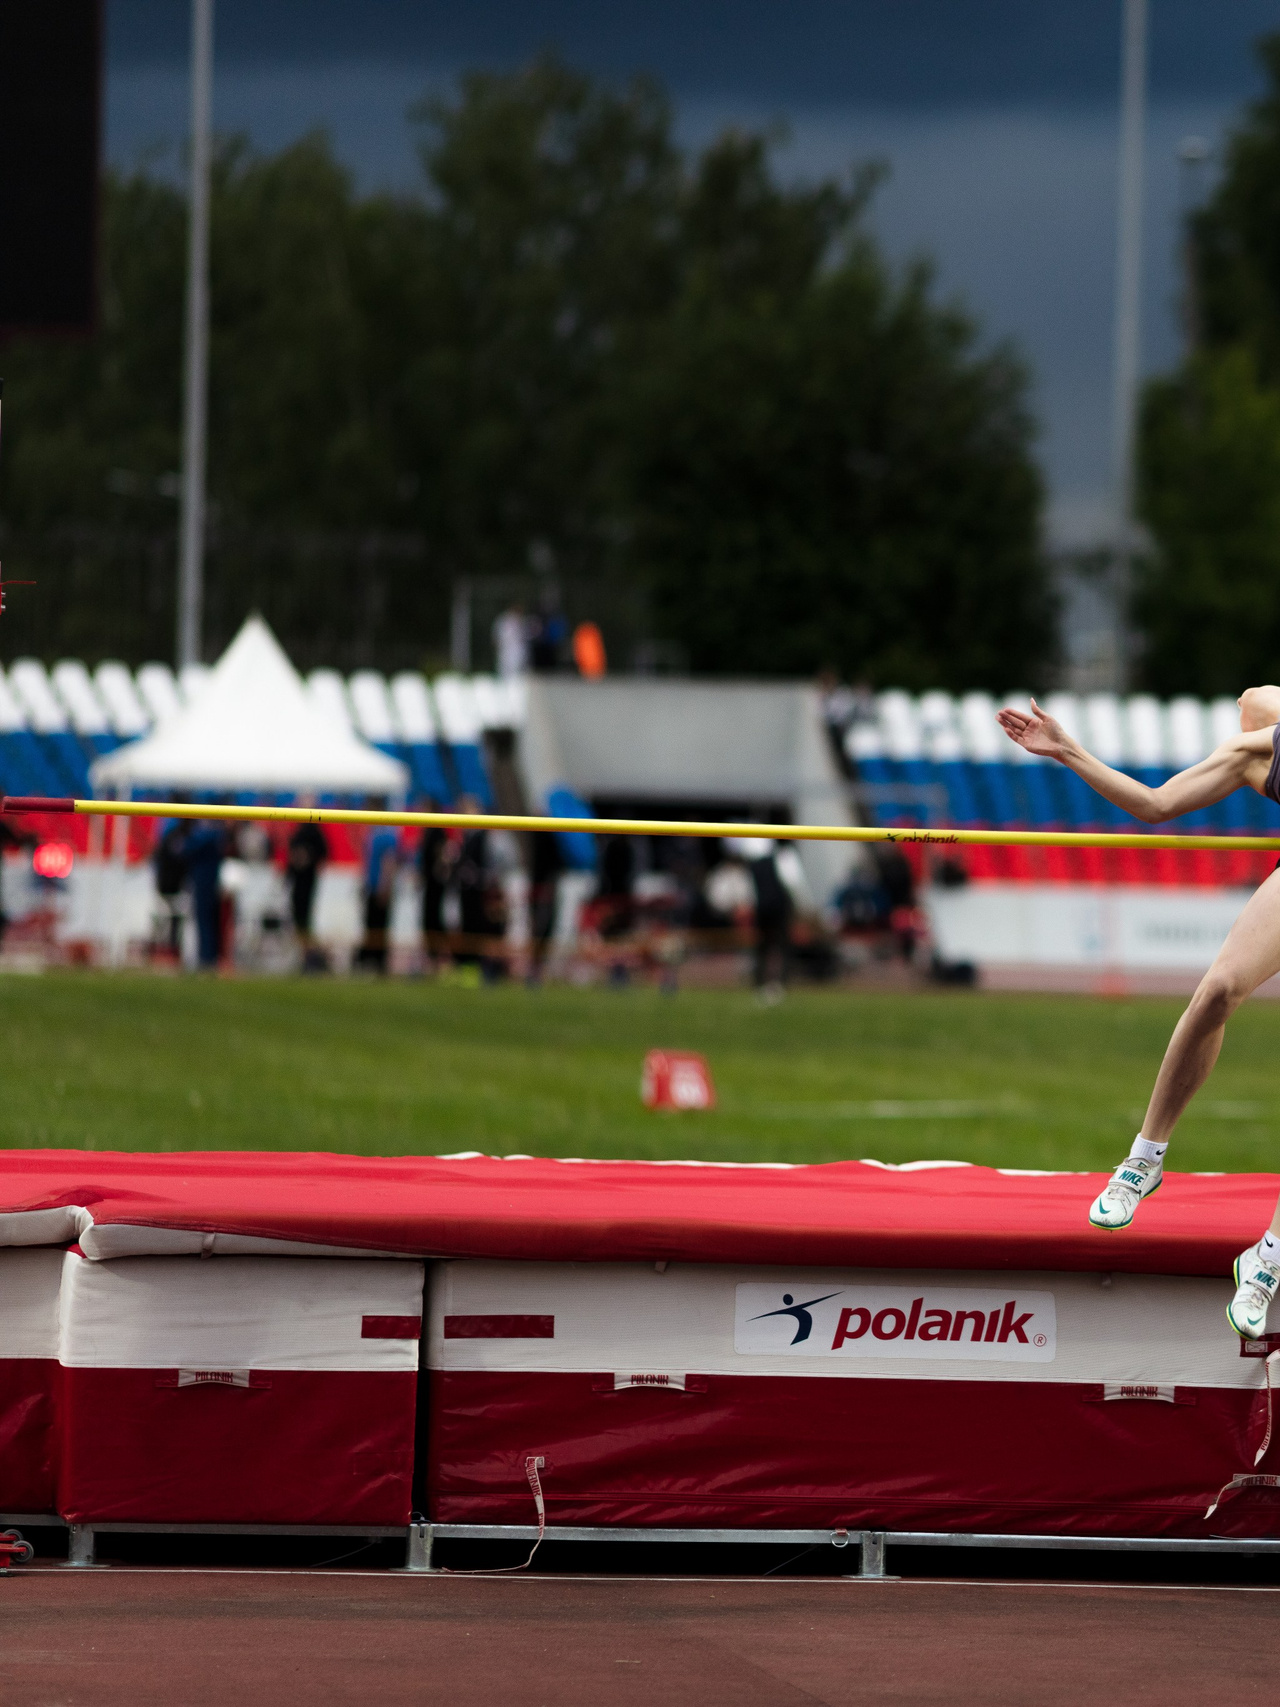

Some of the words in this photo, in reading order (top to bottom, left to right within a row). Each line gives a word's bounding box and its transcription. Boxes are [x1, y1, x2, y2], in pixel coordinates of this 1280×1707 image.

[1119, 1170, 1144, 1186] NIKE
[1253, 1271, 1277, 1289] NIKE
[831, 1297, 1034, 1350] polanik
[194, 1371, 234, 1383] POLANIK
[630, 1374, 669, 1386] POLANIK
[1120, 1385, 1158, 1397] POLANIK
[1241, 1475, 1278, 1487] POLANIK
